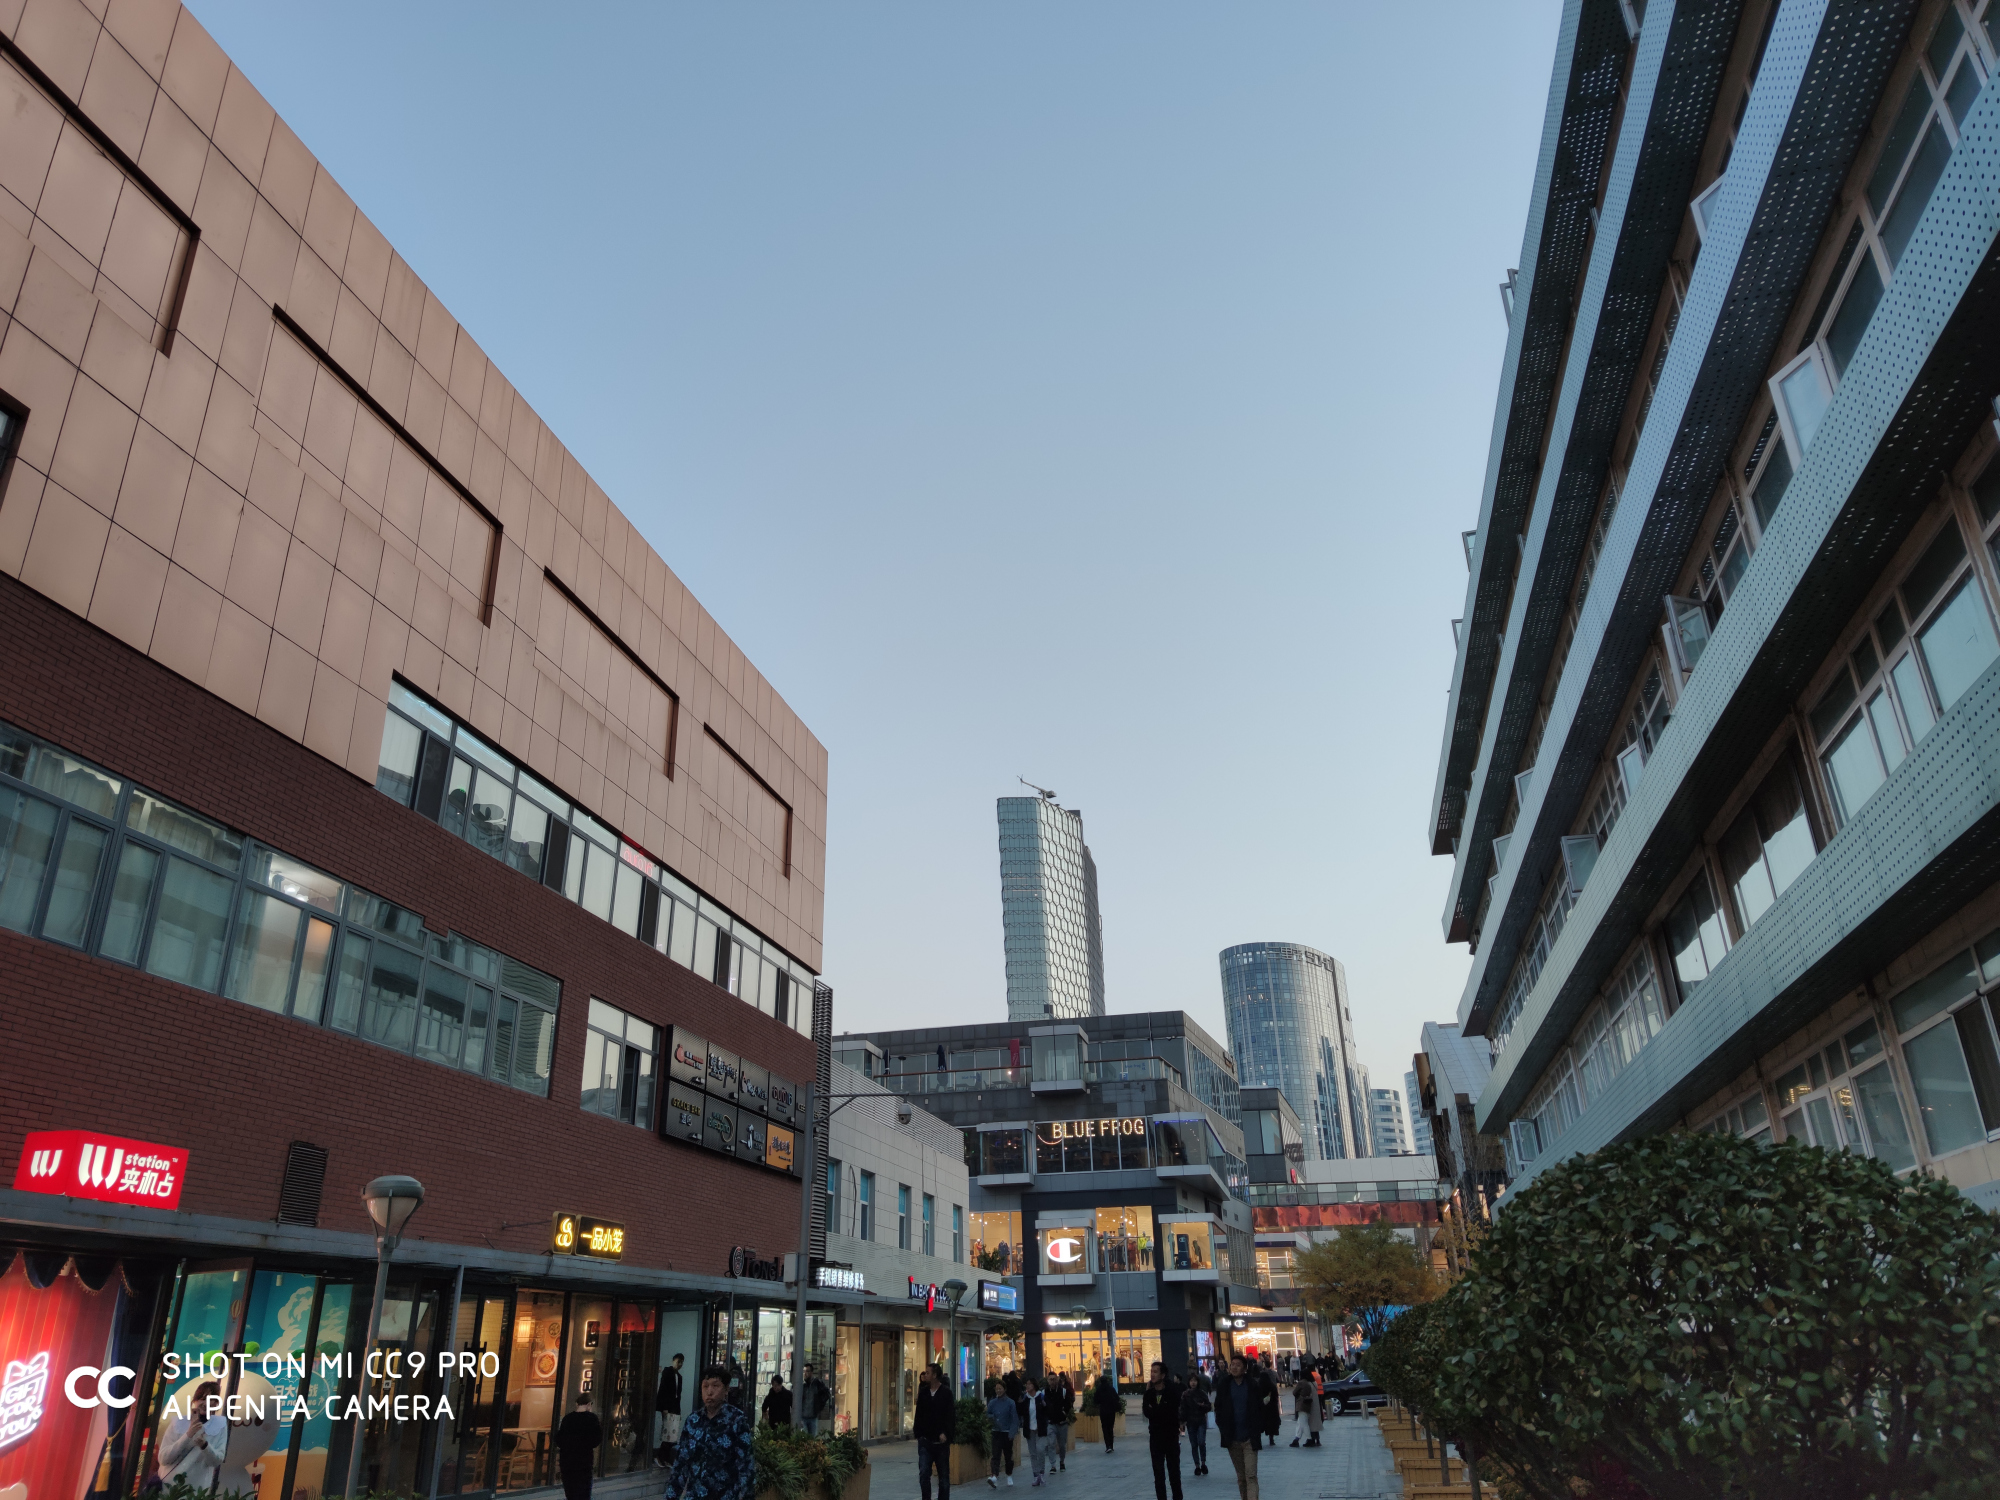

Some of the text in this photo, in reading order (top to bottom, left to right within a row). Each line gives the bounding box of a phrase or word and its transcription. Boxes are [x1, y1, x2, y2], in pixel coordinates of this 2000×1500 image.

[1052, 1118, 1144, 1139] BLUE FROG
[125, 1153, 170, 1171] station
[581, 1227, 624, 1253] 一品小笼
